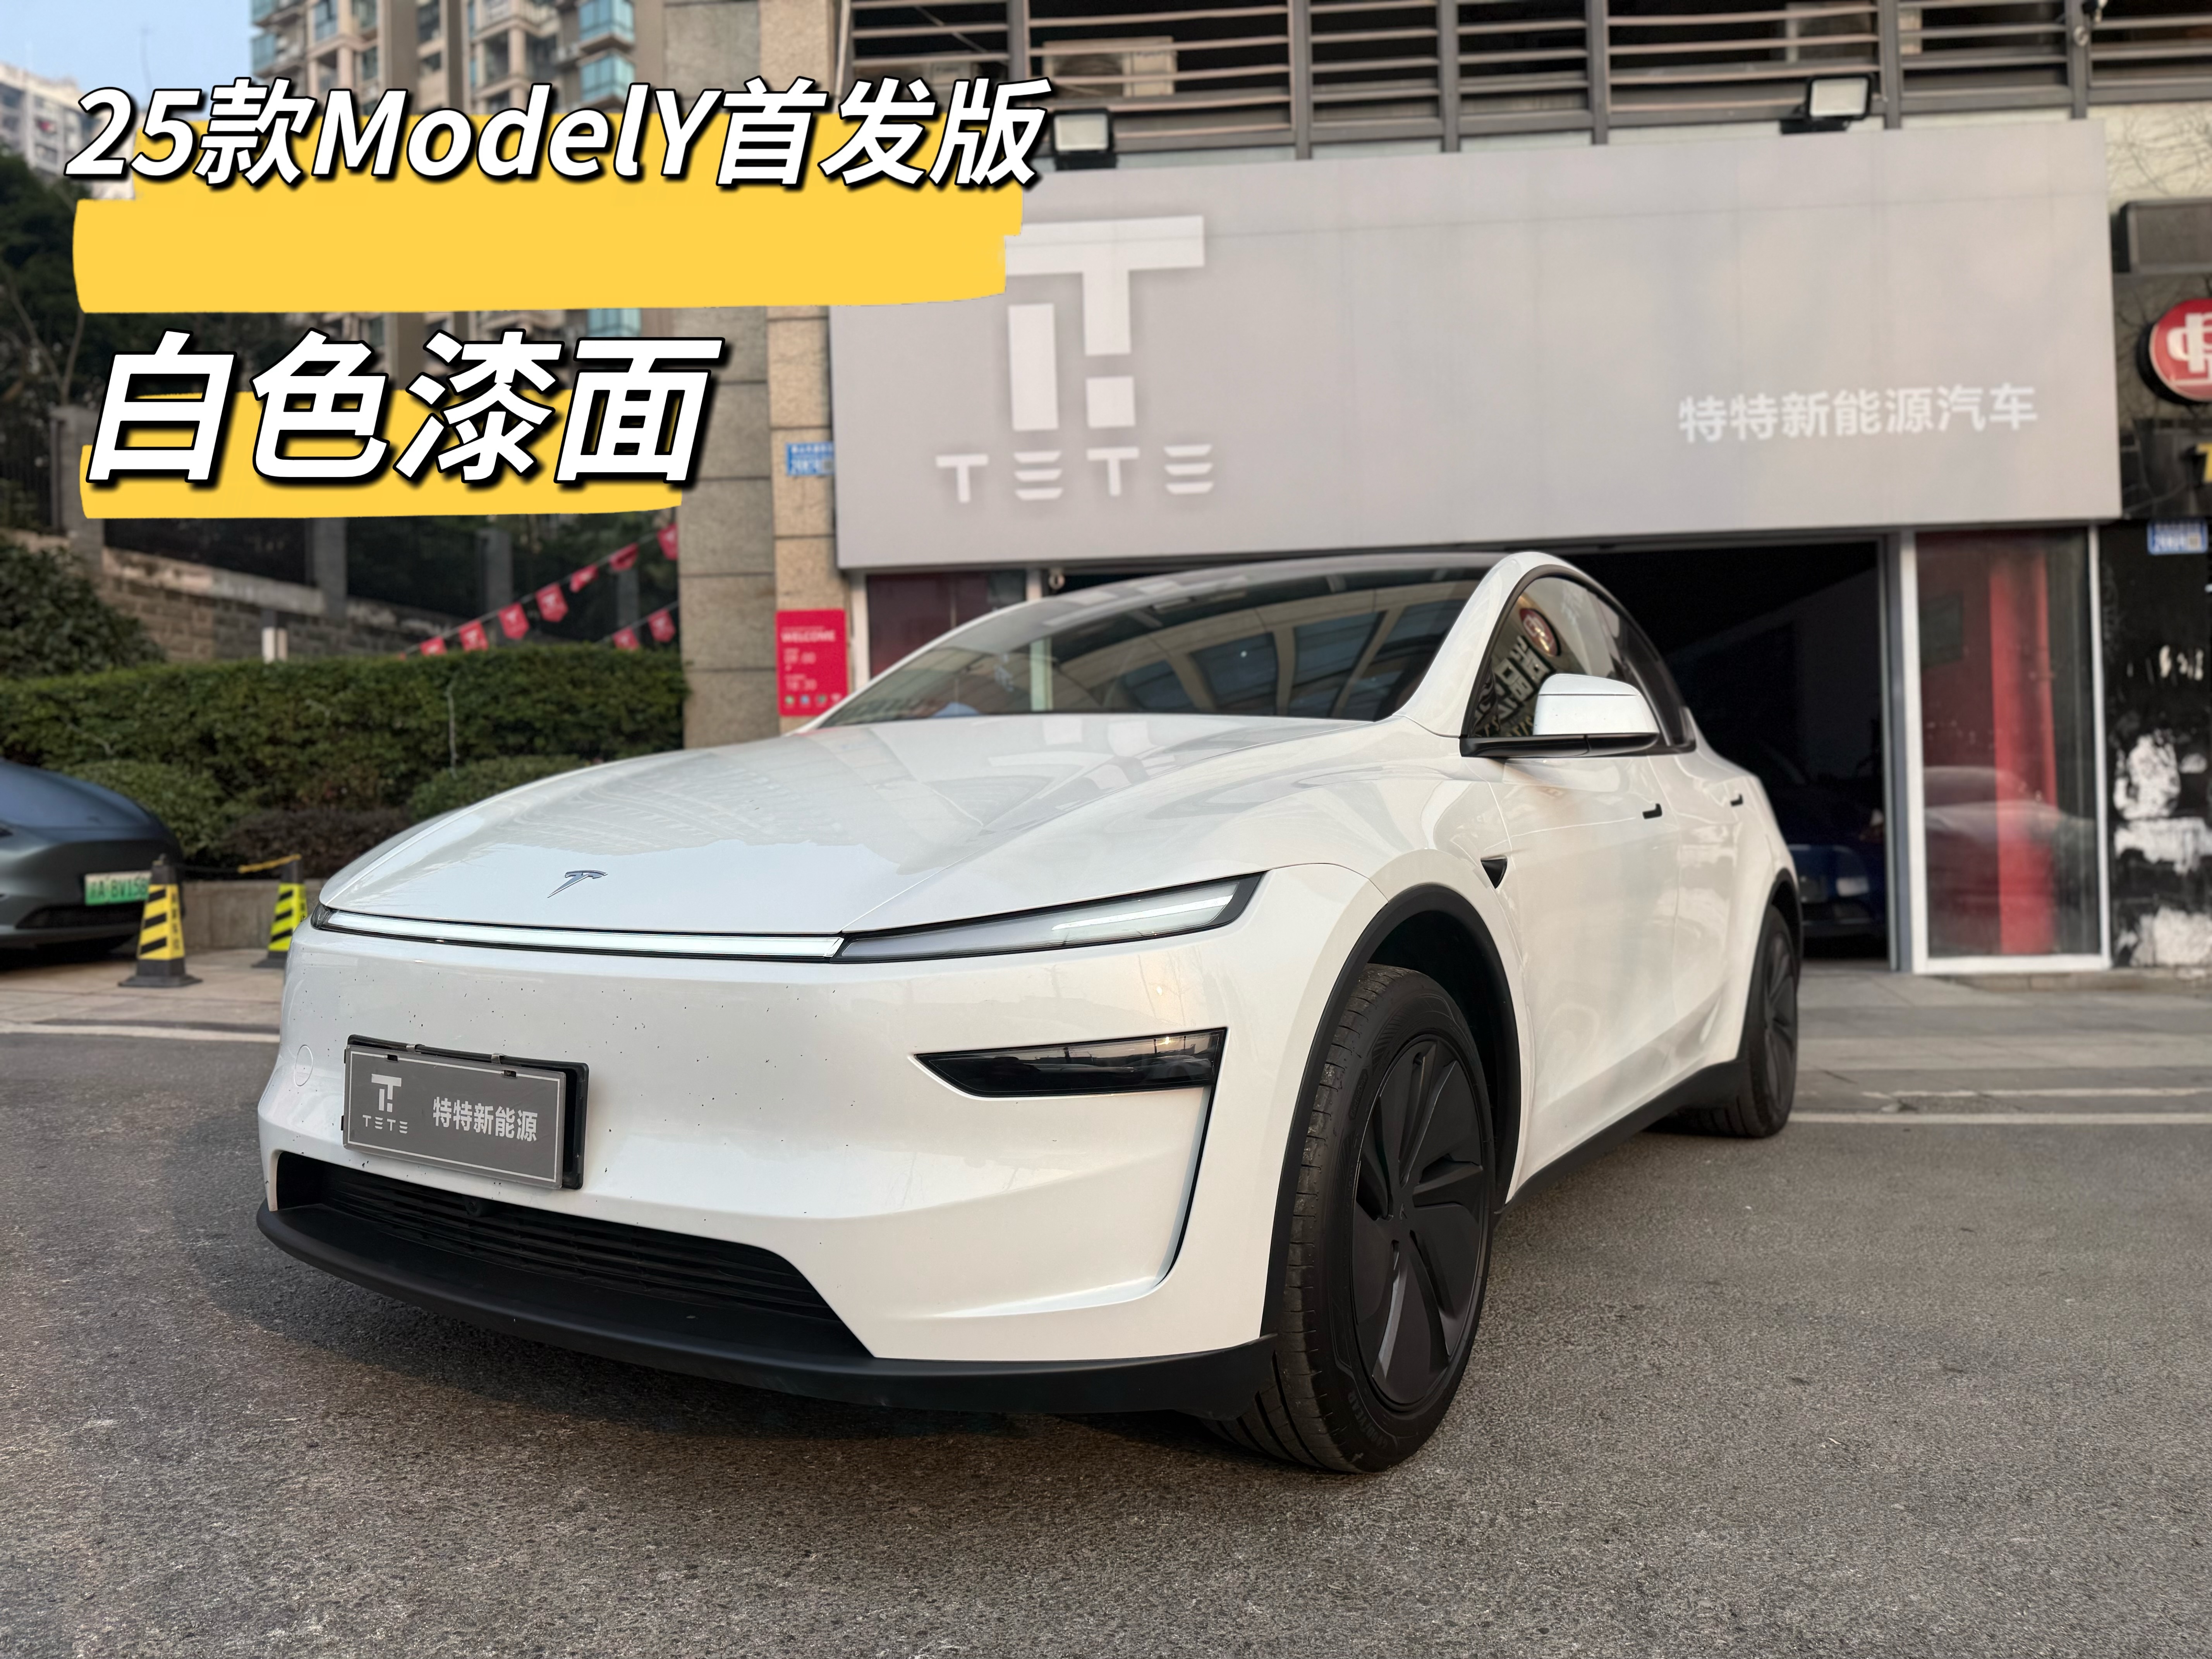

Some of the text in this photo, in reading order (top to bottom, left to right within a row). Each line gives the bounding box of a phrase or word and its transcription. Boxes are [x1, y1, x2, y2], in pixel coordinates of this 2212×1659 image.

[1678, 381, 2039, 443] 特特新能源汽车
[935, 444, 1214, 503] TETE
[432, 1096, 539, 1142] 特特新能源
